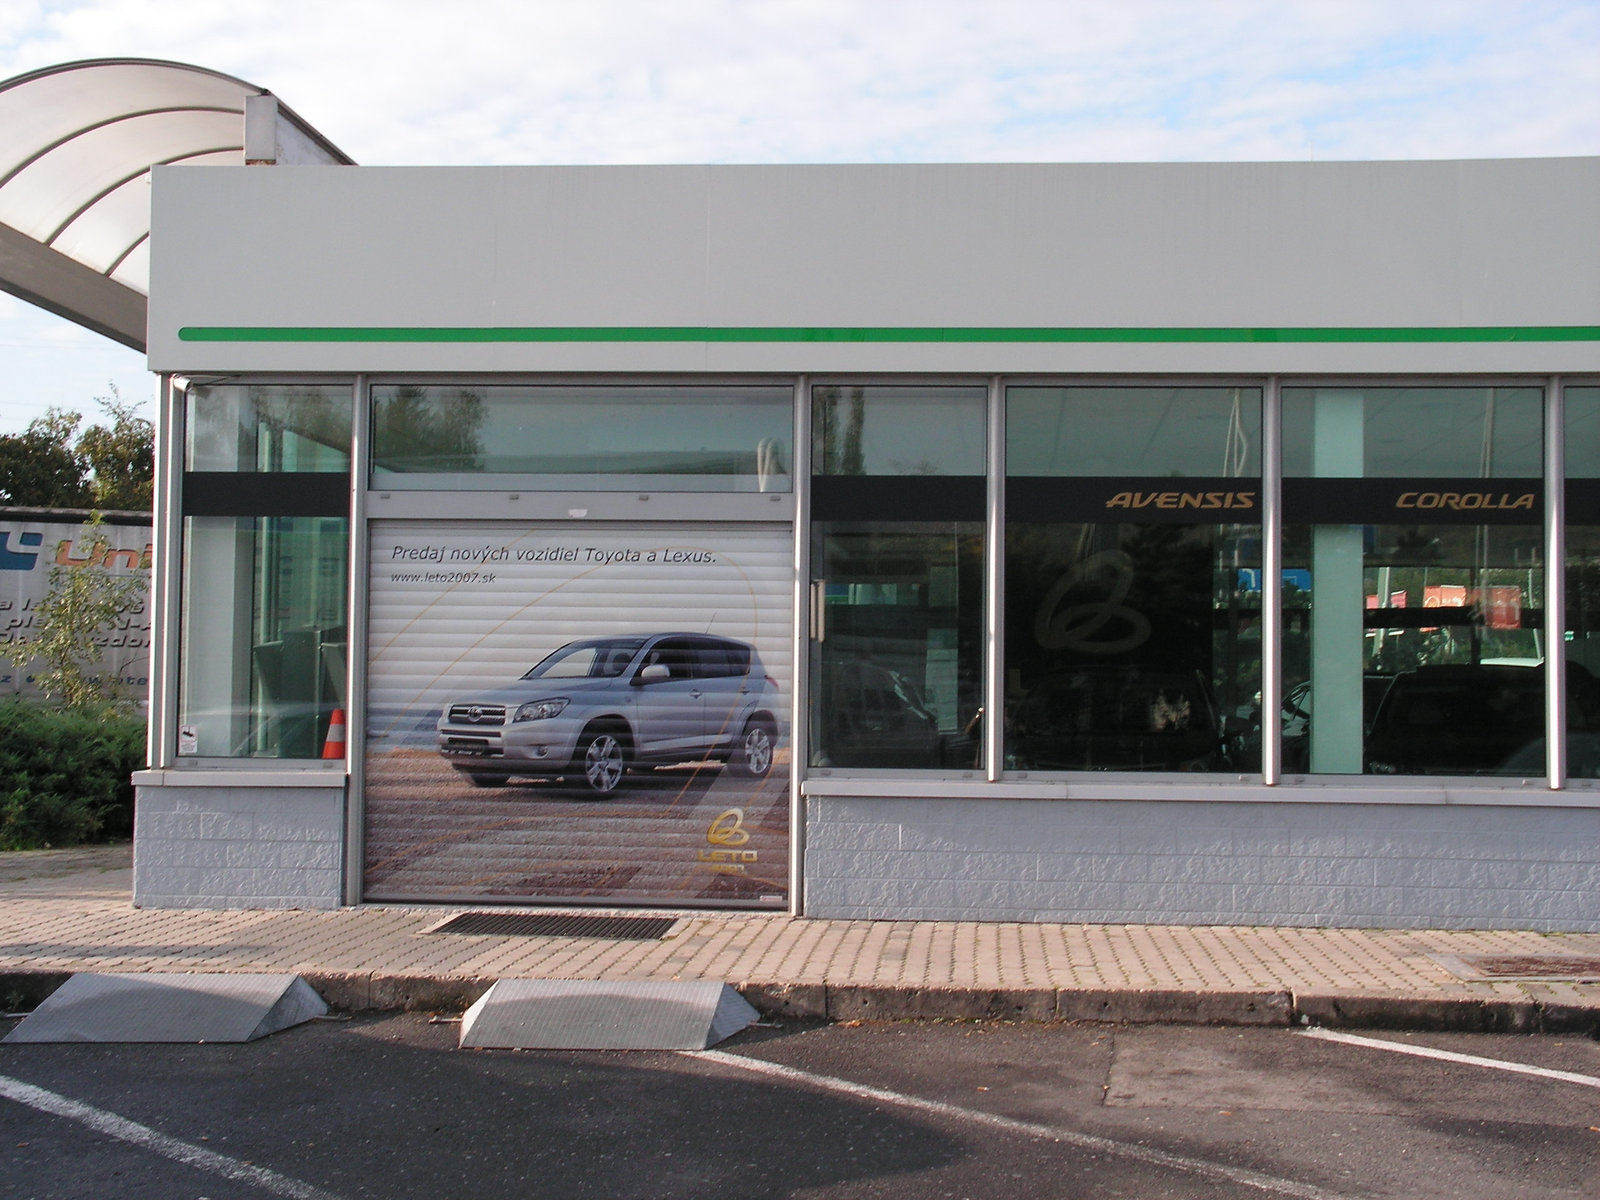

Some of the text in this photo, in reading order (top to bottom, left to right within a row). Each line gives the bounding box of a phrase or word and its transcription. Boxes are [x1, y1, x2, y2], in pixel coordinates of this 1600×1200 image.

[1105, 491, 1256, 509] AVENSIS
[1395, 491, 1536, 511] COROLLA
[391, 545, 717, 565] Predaj nových vozidiel Toyota a Lexus.
[391, 571, 497, 584] www.leto2007.sk
[697, 849, 758, 862] LETO
